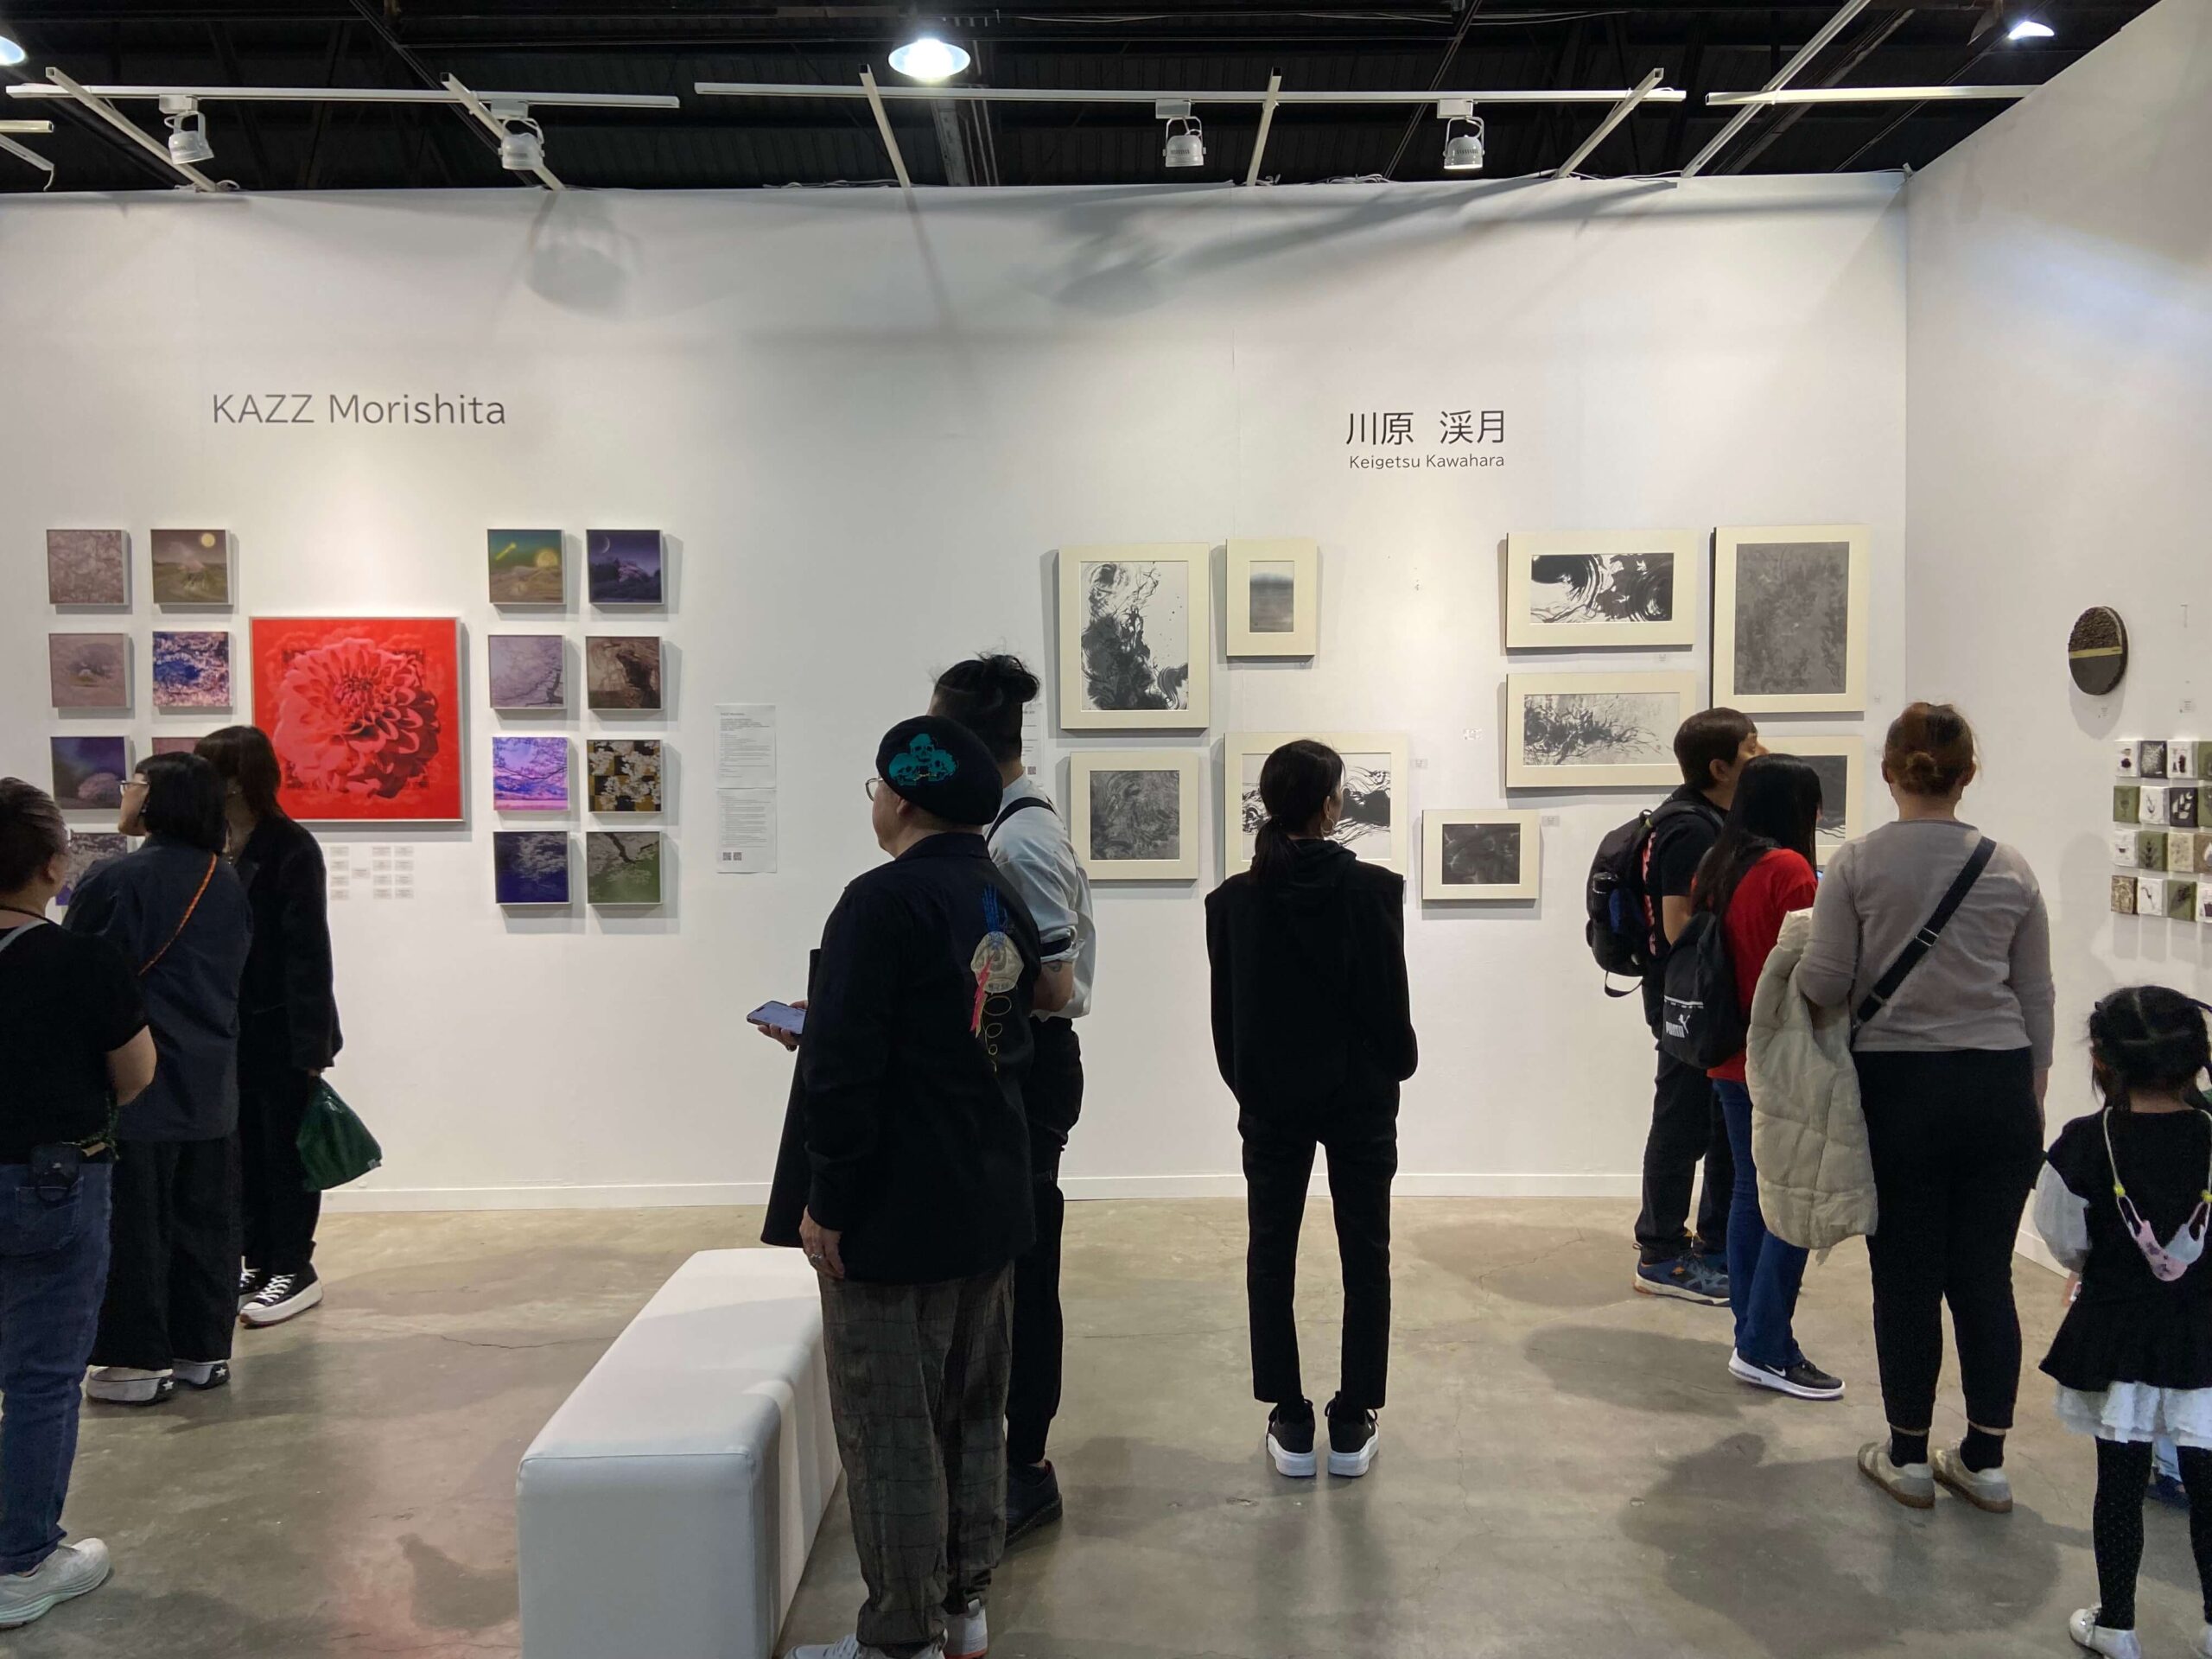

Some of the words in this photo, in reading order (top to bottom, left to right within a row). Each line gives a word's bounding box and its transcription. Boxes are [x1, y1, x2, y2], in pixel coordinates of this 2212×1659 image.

[213, 394, 315, 423] KAZZ
[329, 393, 505, 424] Morishita
[1346, 411, 1414, 445] 川原
[1440, 410, 1504, 444] 渓月
[1350, 455, 1421, 470] Keigetsu
[1426, 454, 1504, 468] Kawahara
